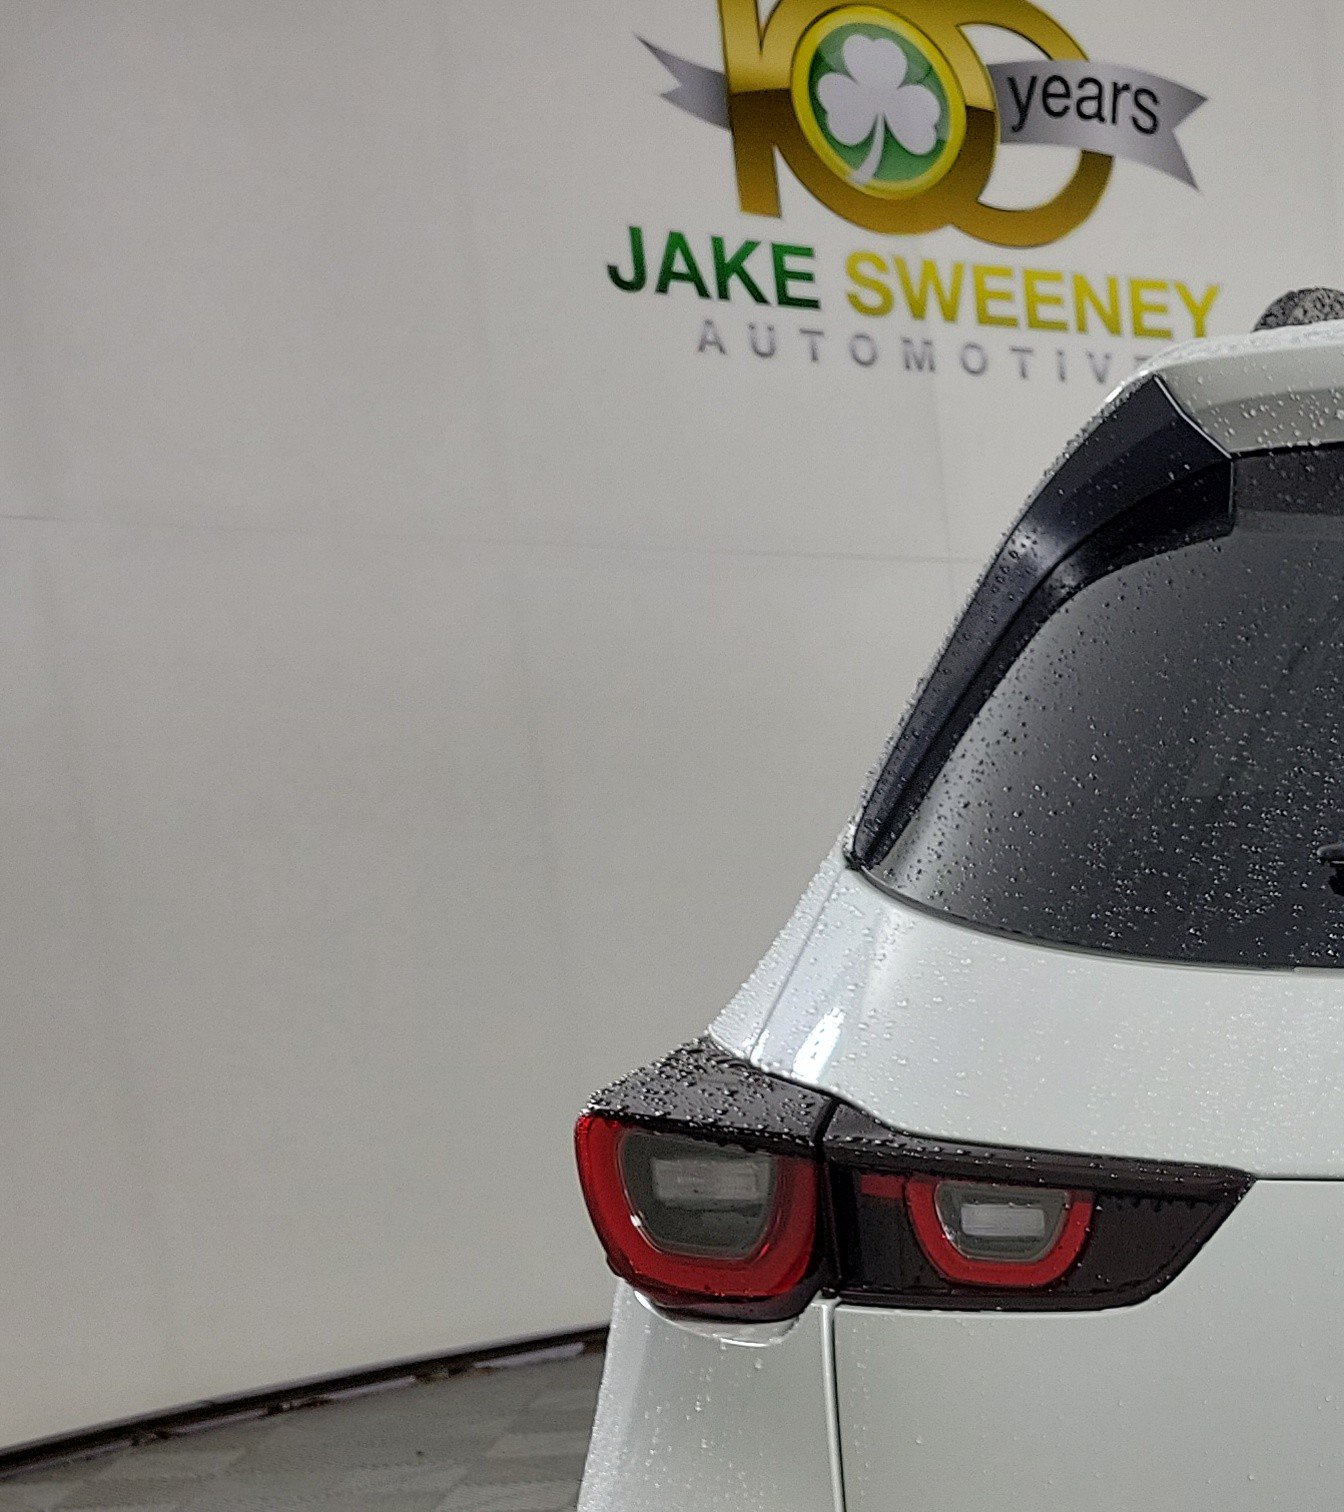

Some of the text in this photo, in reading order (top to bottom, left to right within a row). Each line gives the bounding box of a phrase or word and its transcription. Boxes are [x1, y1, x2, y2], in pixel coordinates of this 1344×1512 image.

[1006, 73, 1160, 136] years
[607, 226, 1221, 340] JAKE SWEENEY
[698, 319, 1152, 386] AUTOMOTIV
